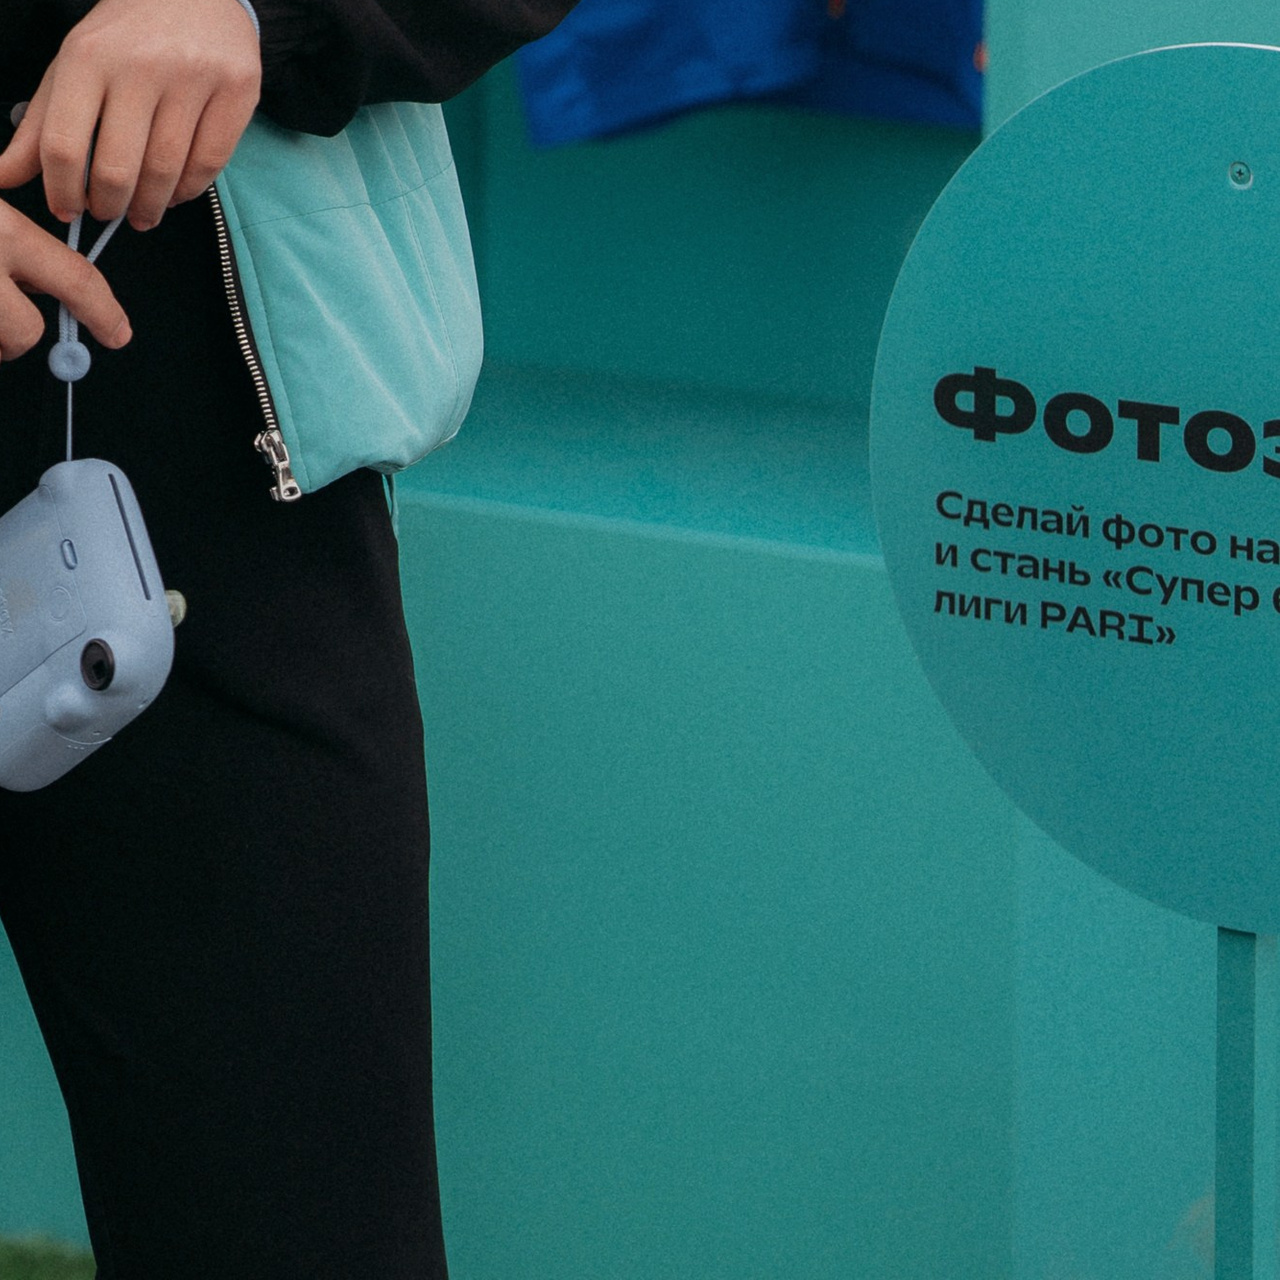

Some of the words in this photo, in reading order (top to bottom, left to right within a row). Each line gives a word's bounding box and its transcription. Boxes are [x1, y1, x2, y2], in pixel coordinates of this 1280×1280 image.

[933, 366, 1280, 480] Фото
[935, 490, 1090, 539] Сделай
[1102, 513, 1217, 556] фото
[935, 541, 959, 568] и
[969, 545, 1092, 587] стань
[1102, 564, 1260, 616] «Супер
[933, 589, 1028, 626] лиги
[1040, 600, 1177, 646] PARI»
